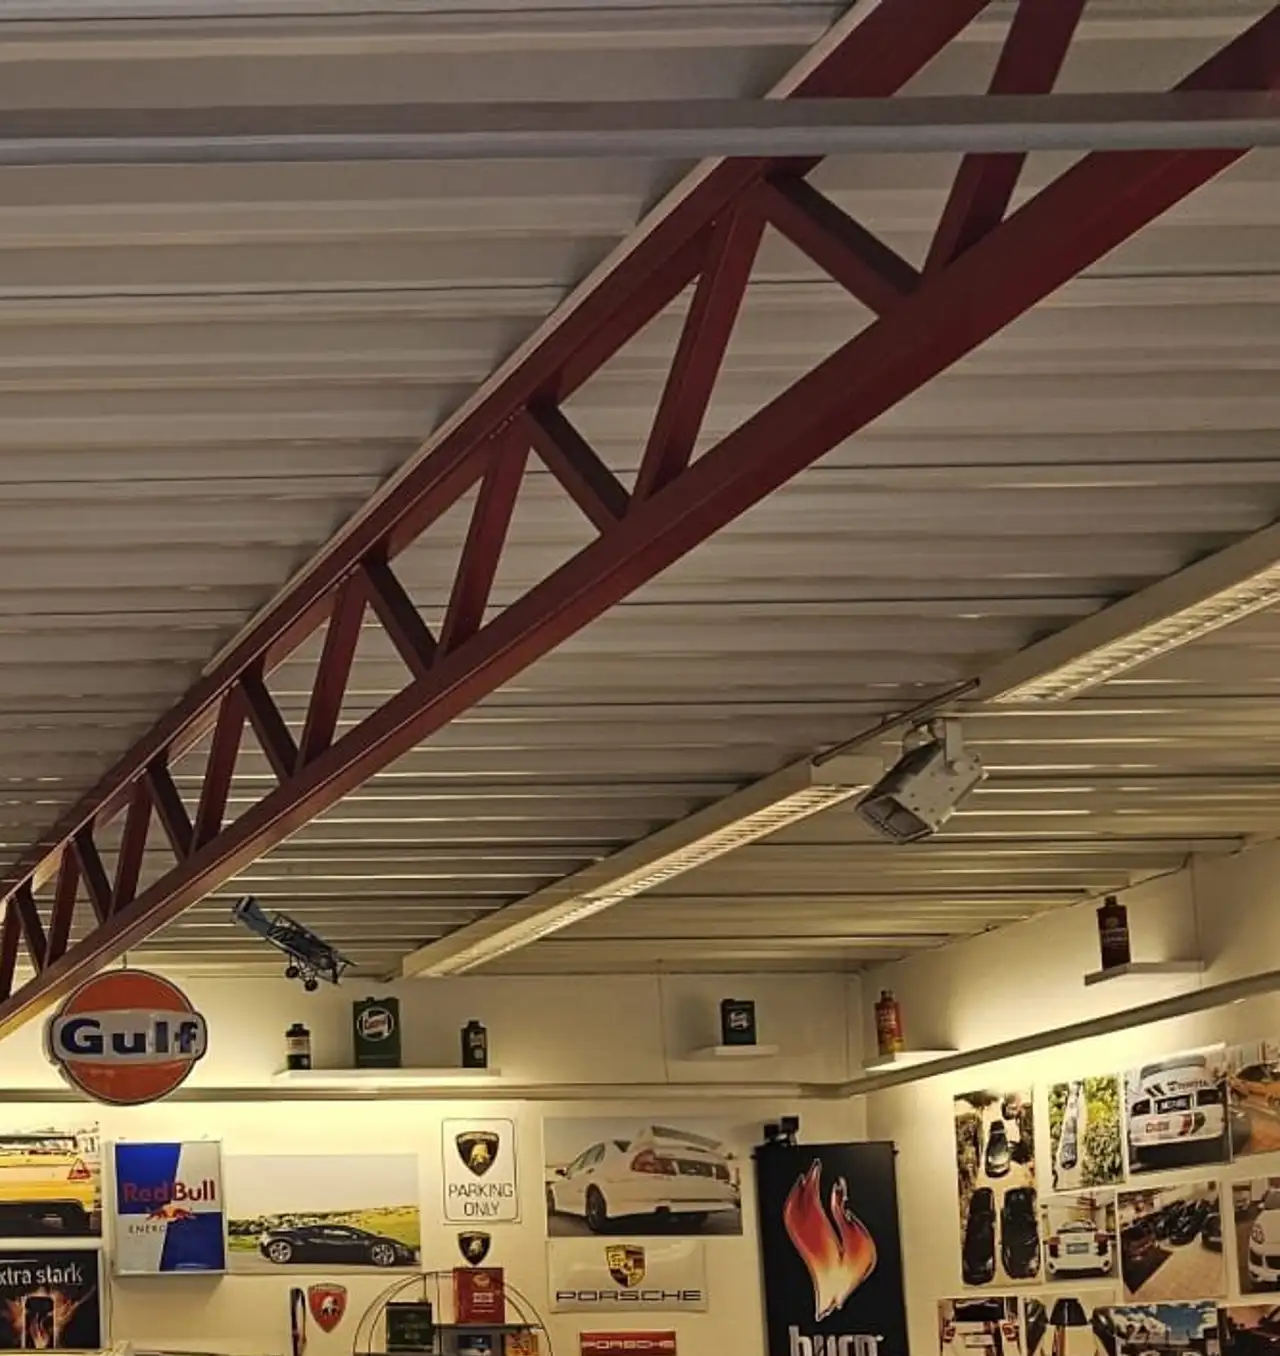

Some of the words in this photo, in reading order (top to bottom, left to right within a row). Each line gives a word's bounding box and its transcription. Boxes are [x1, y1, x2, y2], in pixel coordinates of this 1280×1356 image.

[60, 1018, 198, 1054] Gulf
[123, 1181, 171, 1202] Red
[173, 1180, 215, 1201] Bull
[448, 1183, 513, 1197] PARKING
[464, 1202, 500, 1216] ONLY
[36, 1262, 83, 1284] stark
[556, 1290, 701, 1302] PORSCHE
